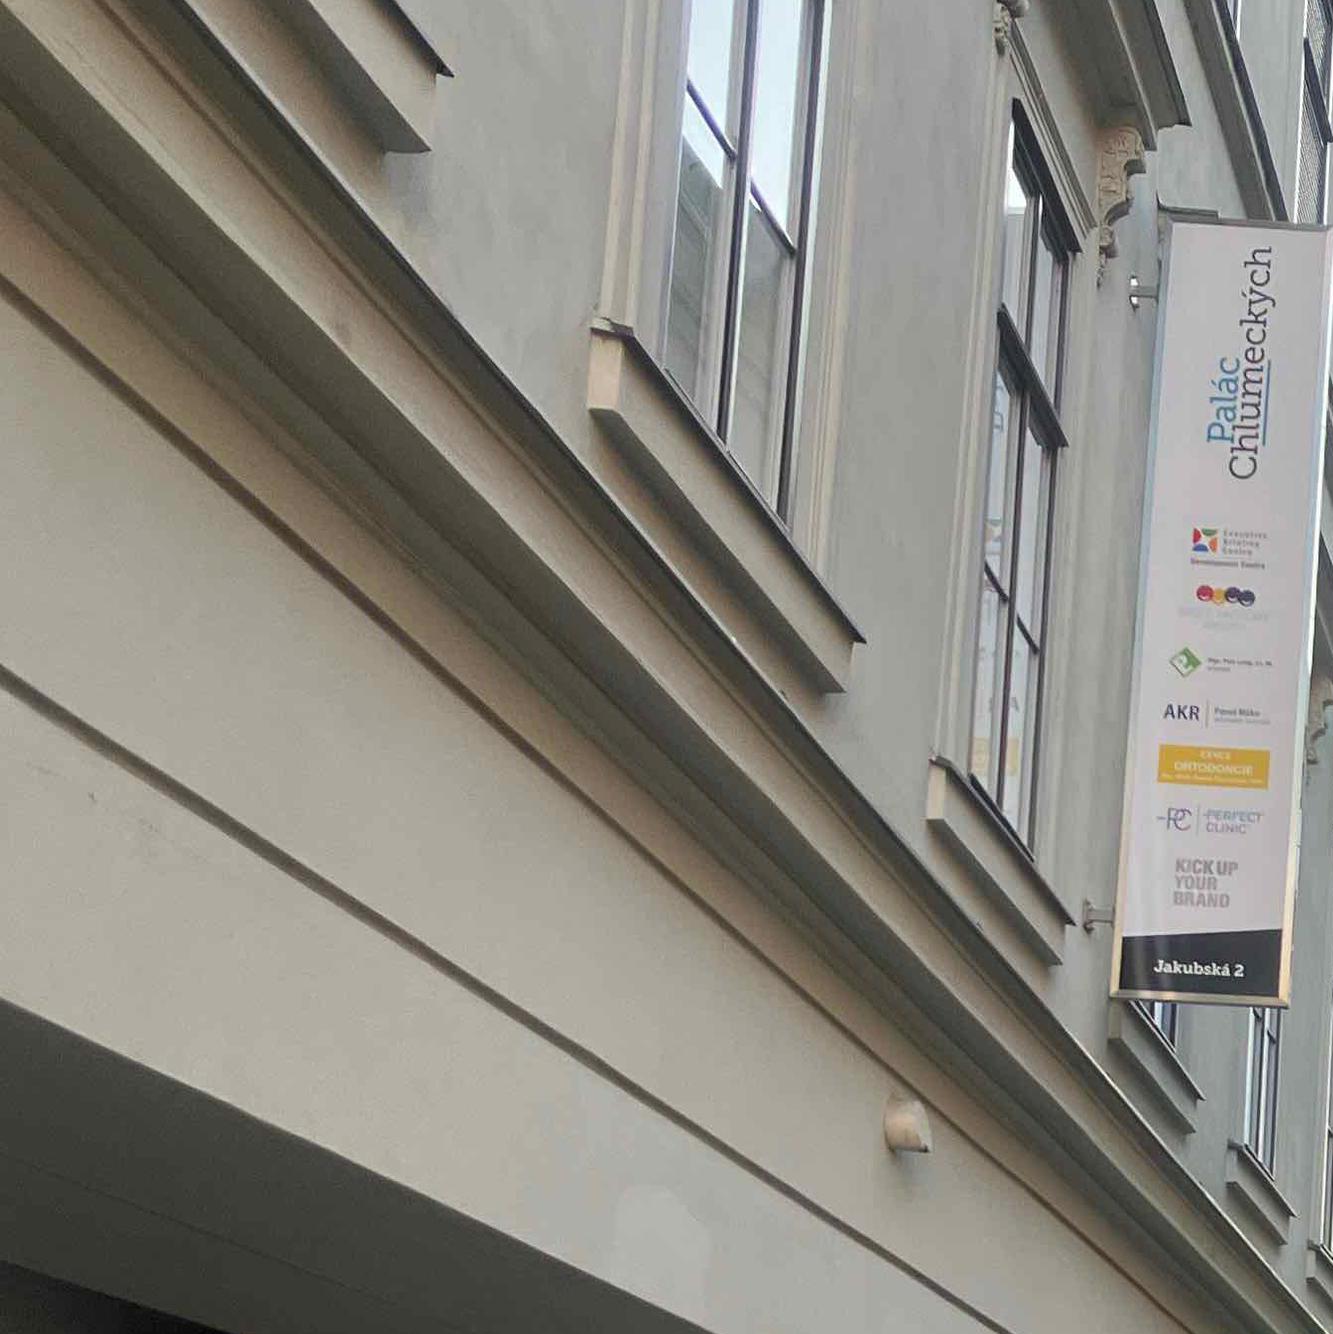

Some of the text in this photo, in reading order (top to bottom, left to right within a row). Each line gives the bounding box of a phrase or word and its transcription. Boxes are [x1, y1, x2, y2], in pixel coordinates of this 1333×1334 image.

[1229, 245, 1276, 480] Chlumeckých
[1207, 356, 1241, 444] Palác
[1163, 704, 1200, 722] AKR
[1206, 822, 1247, 835] CLINIC
[1175, 858, 1239, 876] KICK UP
[1175, 875, 1218, 891] YOUR
[1173, 891, 1230, 908] BRAND
[1153, 959, 1245, 978] Jakubská 2
